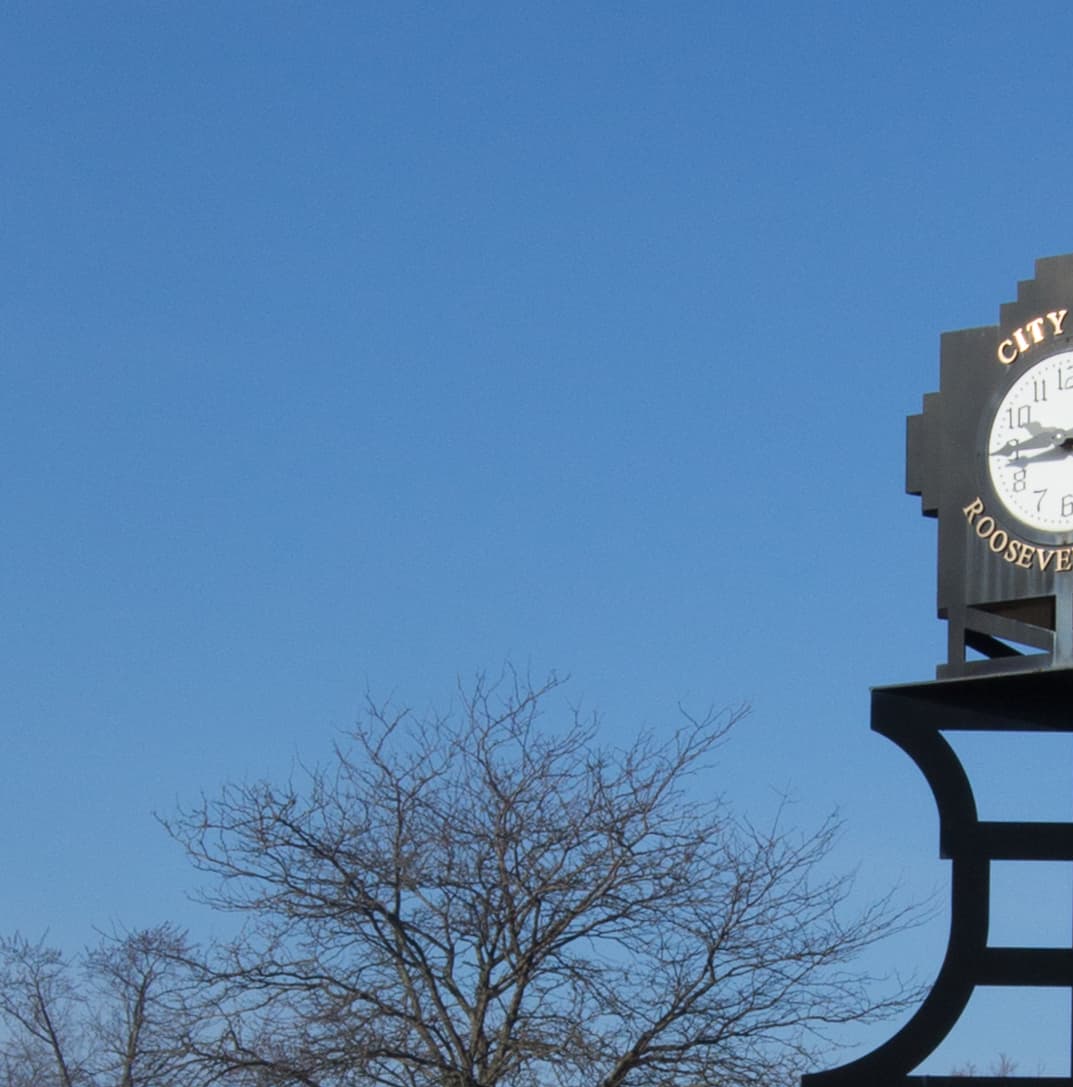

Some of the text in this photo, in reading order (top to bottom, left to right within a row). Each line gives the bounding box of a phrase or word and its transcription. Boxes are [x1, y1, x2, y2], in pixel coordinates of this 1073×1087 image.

[998, 310, 1067, 364] CITY
[1034, 380, 1047, 401] 11
[1007, 406, 1030, 429] 10
[1013, 469, 1026, 492] 8
[1034, 489, 1047, 511] 7
[1061, 495, 1073, 517] 6
